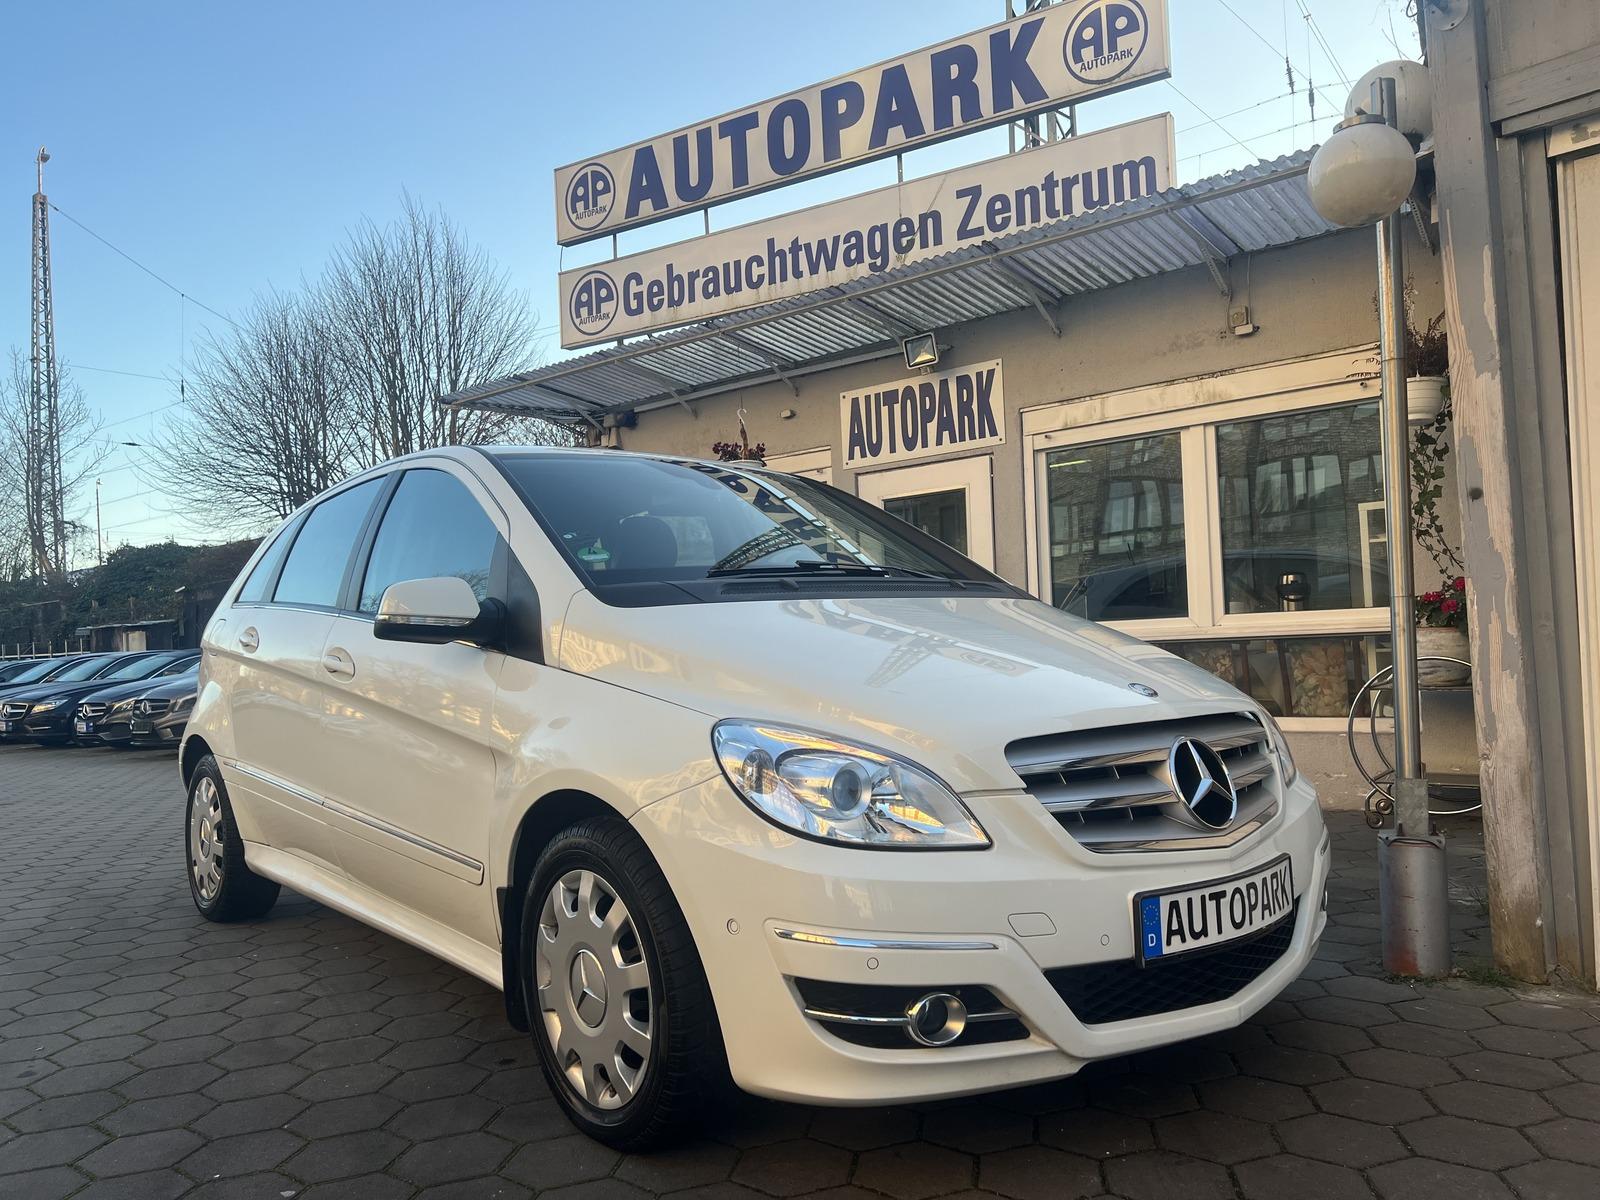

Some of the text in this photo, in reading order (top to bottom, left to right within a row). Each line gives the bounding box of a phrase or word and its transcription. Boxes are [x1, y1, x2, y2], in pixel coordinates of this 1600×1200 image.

[1071, 3, 1141, 65] AP
[1079, 47, 1134, 73] AUTOPARK
[624, 16, 1050, 220] AUTOPARK
[571, 170, 611, 214] AP
[574, 205, 608, 221] AUTOPARK
[622, 155, 1158, 317] Gebrauchtwagen Zentrum
[574, 277, 615, 318] AP
[578, 310, 611, 327] AUTOPARK
[848, 368, 999, 461] AUTOPARK
[1148, 865, 1290, 947] D AUTOPARK
